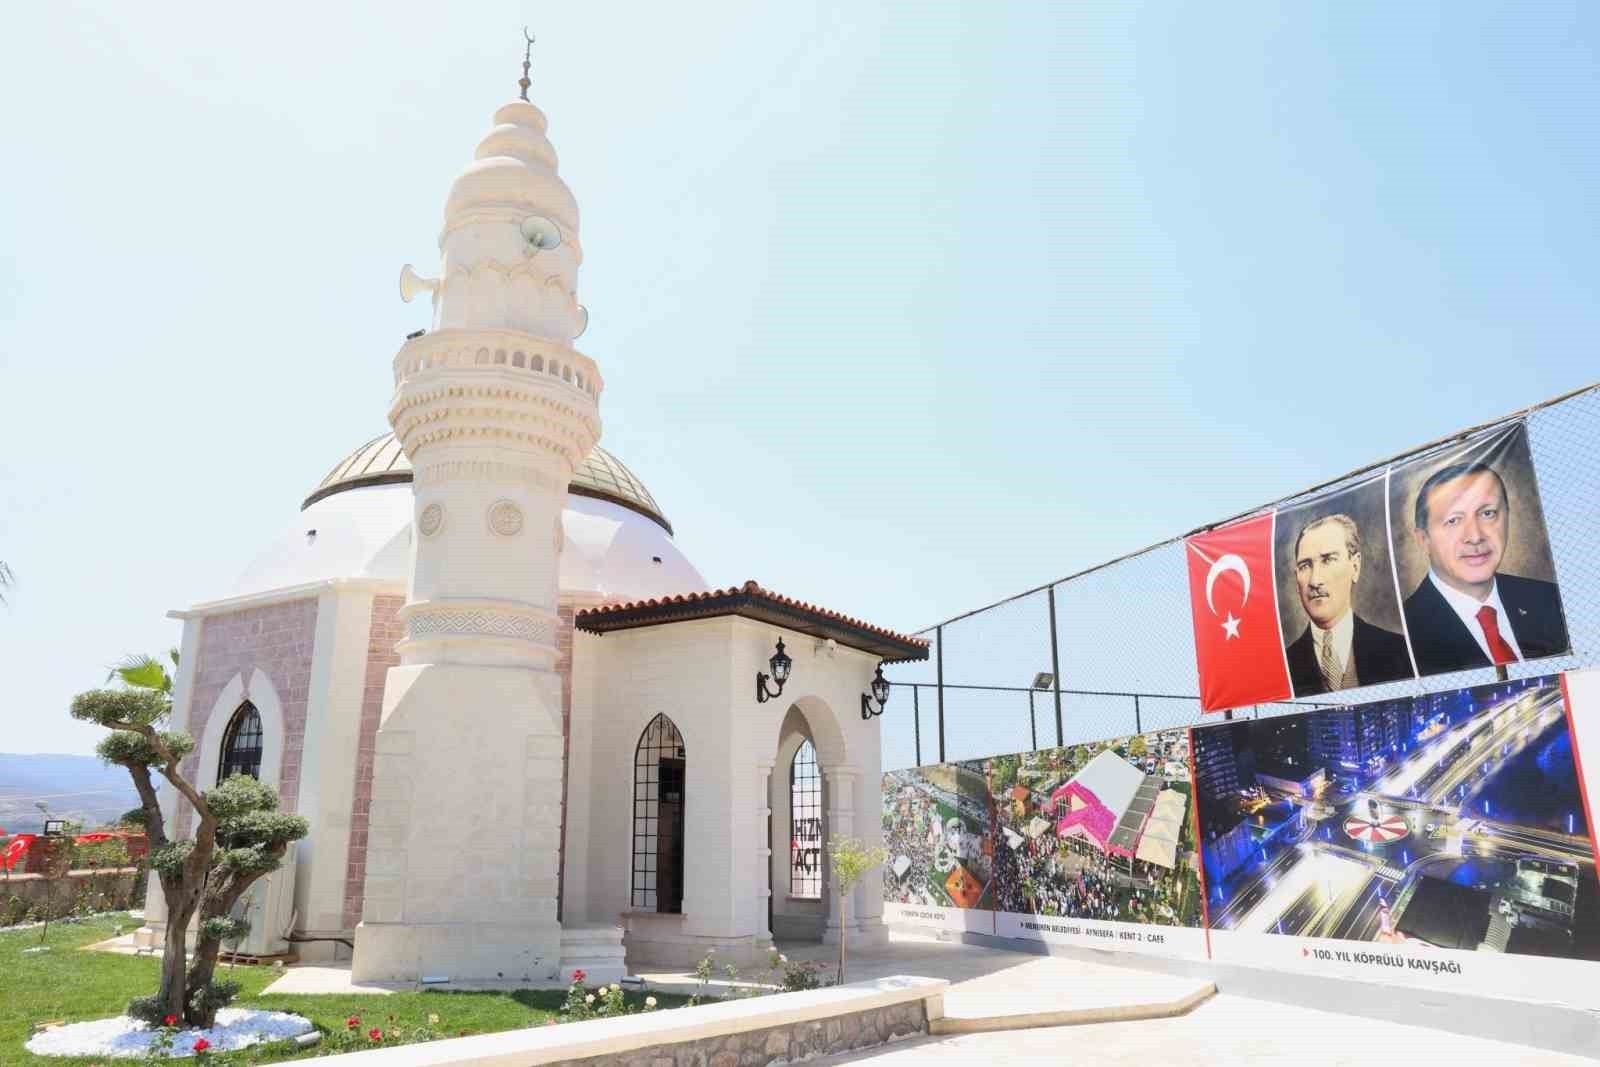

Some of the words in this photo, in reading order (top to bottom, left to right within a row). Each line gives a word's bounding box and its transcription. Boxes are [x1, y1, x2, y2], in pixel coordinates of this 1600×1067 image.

[1119, 930, 1135, 940] KENT
[1137, 932, 1142, 942] 2
[1147, 934, 1165, 944] CAFE
[1313, 949, 1334, 961] 100.
[1335, 951, 1351, 962] YIL
[1353, 952, 1404, 968] KÖPRÜLÜ
[1407, 957, 1462, 975] KAVŞAĞI
